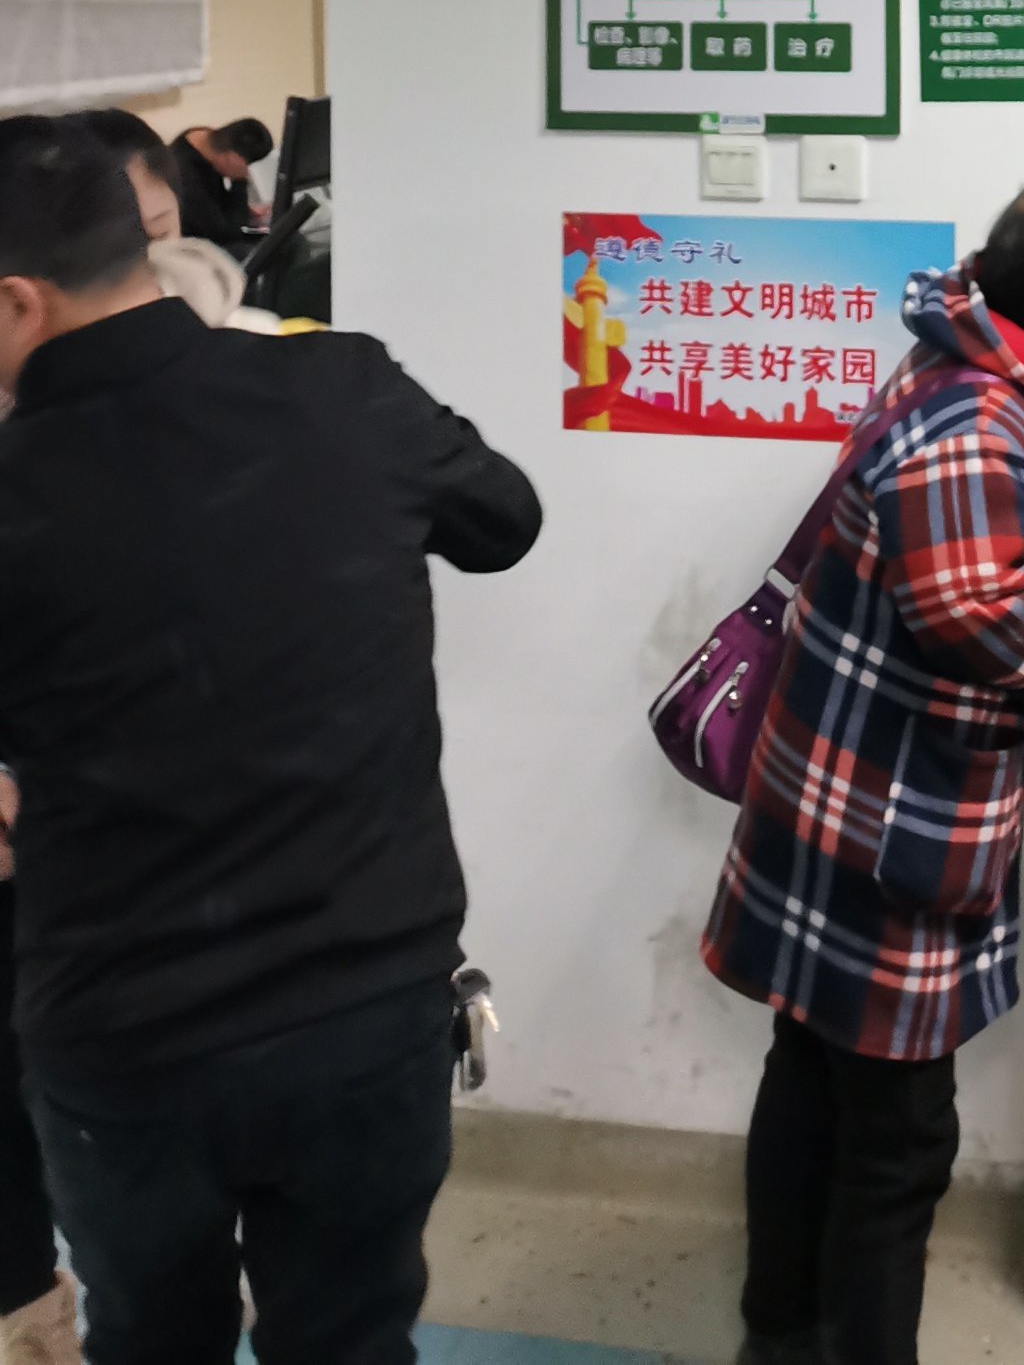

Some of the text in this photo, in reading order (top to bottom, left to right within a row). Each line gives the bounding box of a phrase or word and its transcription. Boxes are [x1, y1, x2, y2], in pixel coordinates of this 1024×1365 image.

[639, 277, 878, 324] 共建文明城市
[639, 338, 877, 385] 共享美好家园
